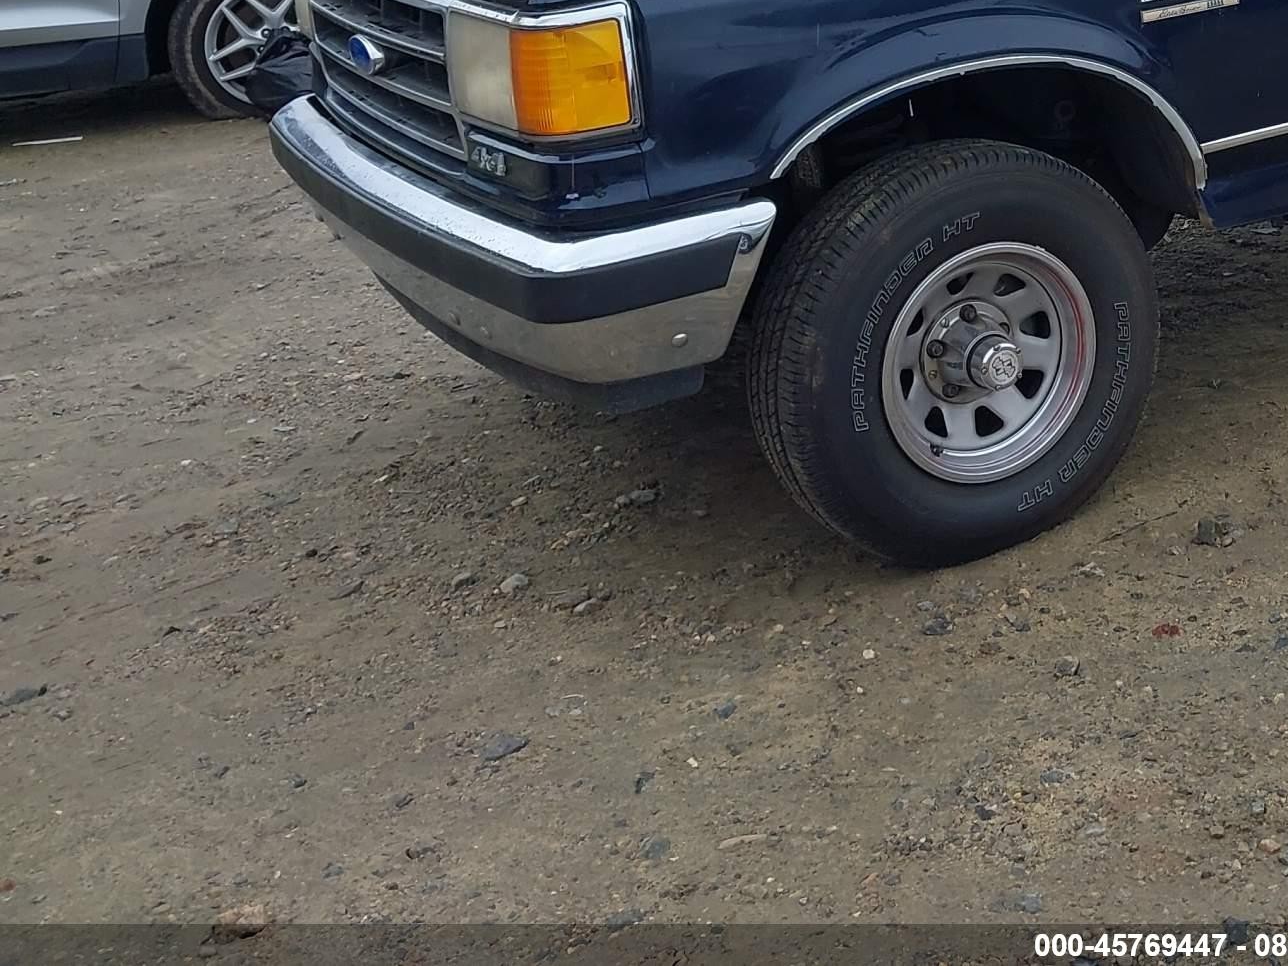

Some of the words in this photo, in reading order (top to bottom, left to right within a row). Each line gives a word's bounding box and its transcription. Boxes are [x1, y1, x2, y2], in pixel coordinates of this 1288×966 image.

[850, 236, 934, 432] PATHFINDER
[943, 212, 980, 242] HT
[1058, 301, 1131, 483] PATHFINDER
[1018, 479, 1053, 511] HT
